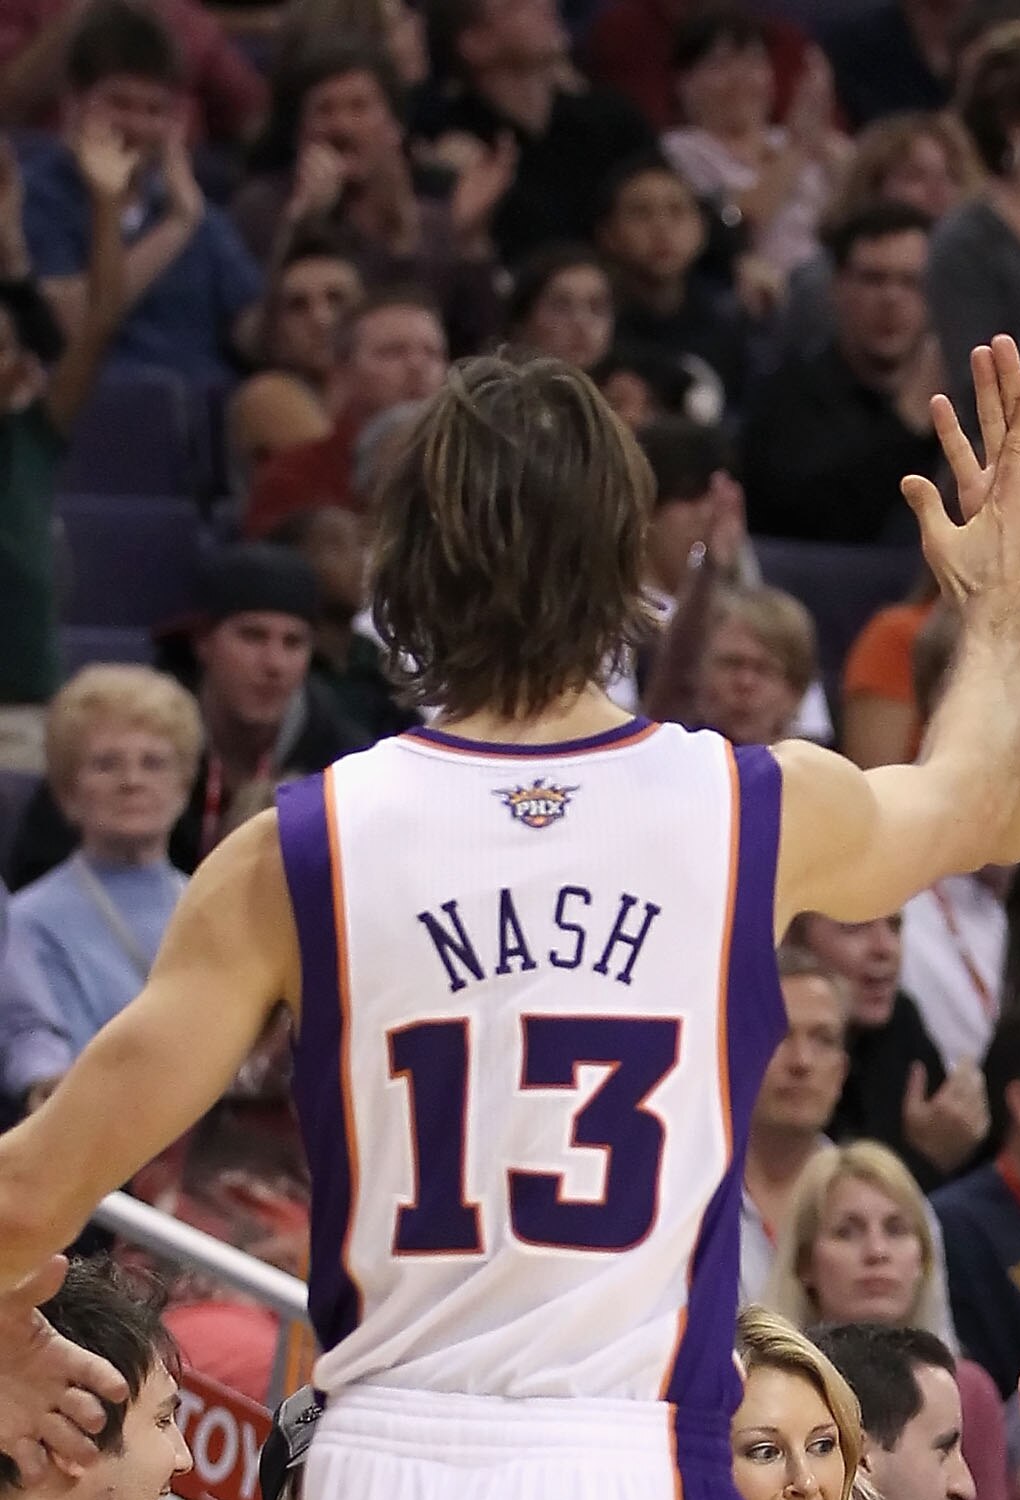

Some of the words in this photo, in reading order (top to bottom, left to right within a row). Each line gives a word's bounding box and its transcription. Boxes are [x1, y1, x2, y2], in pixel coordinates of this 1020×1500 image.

[515, 799, 562, 817] PHX
[418, 885, 662, 993] NASH
[385, 1012, 684, 1257] 13
